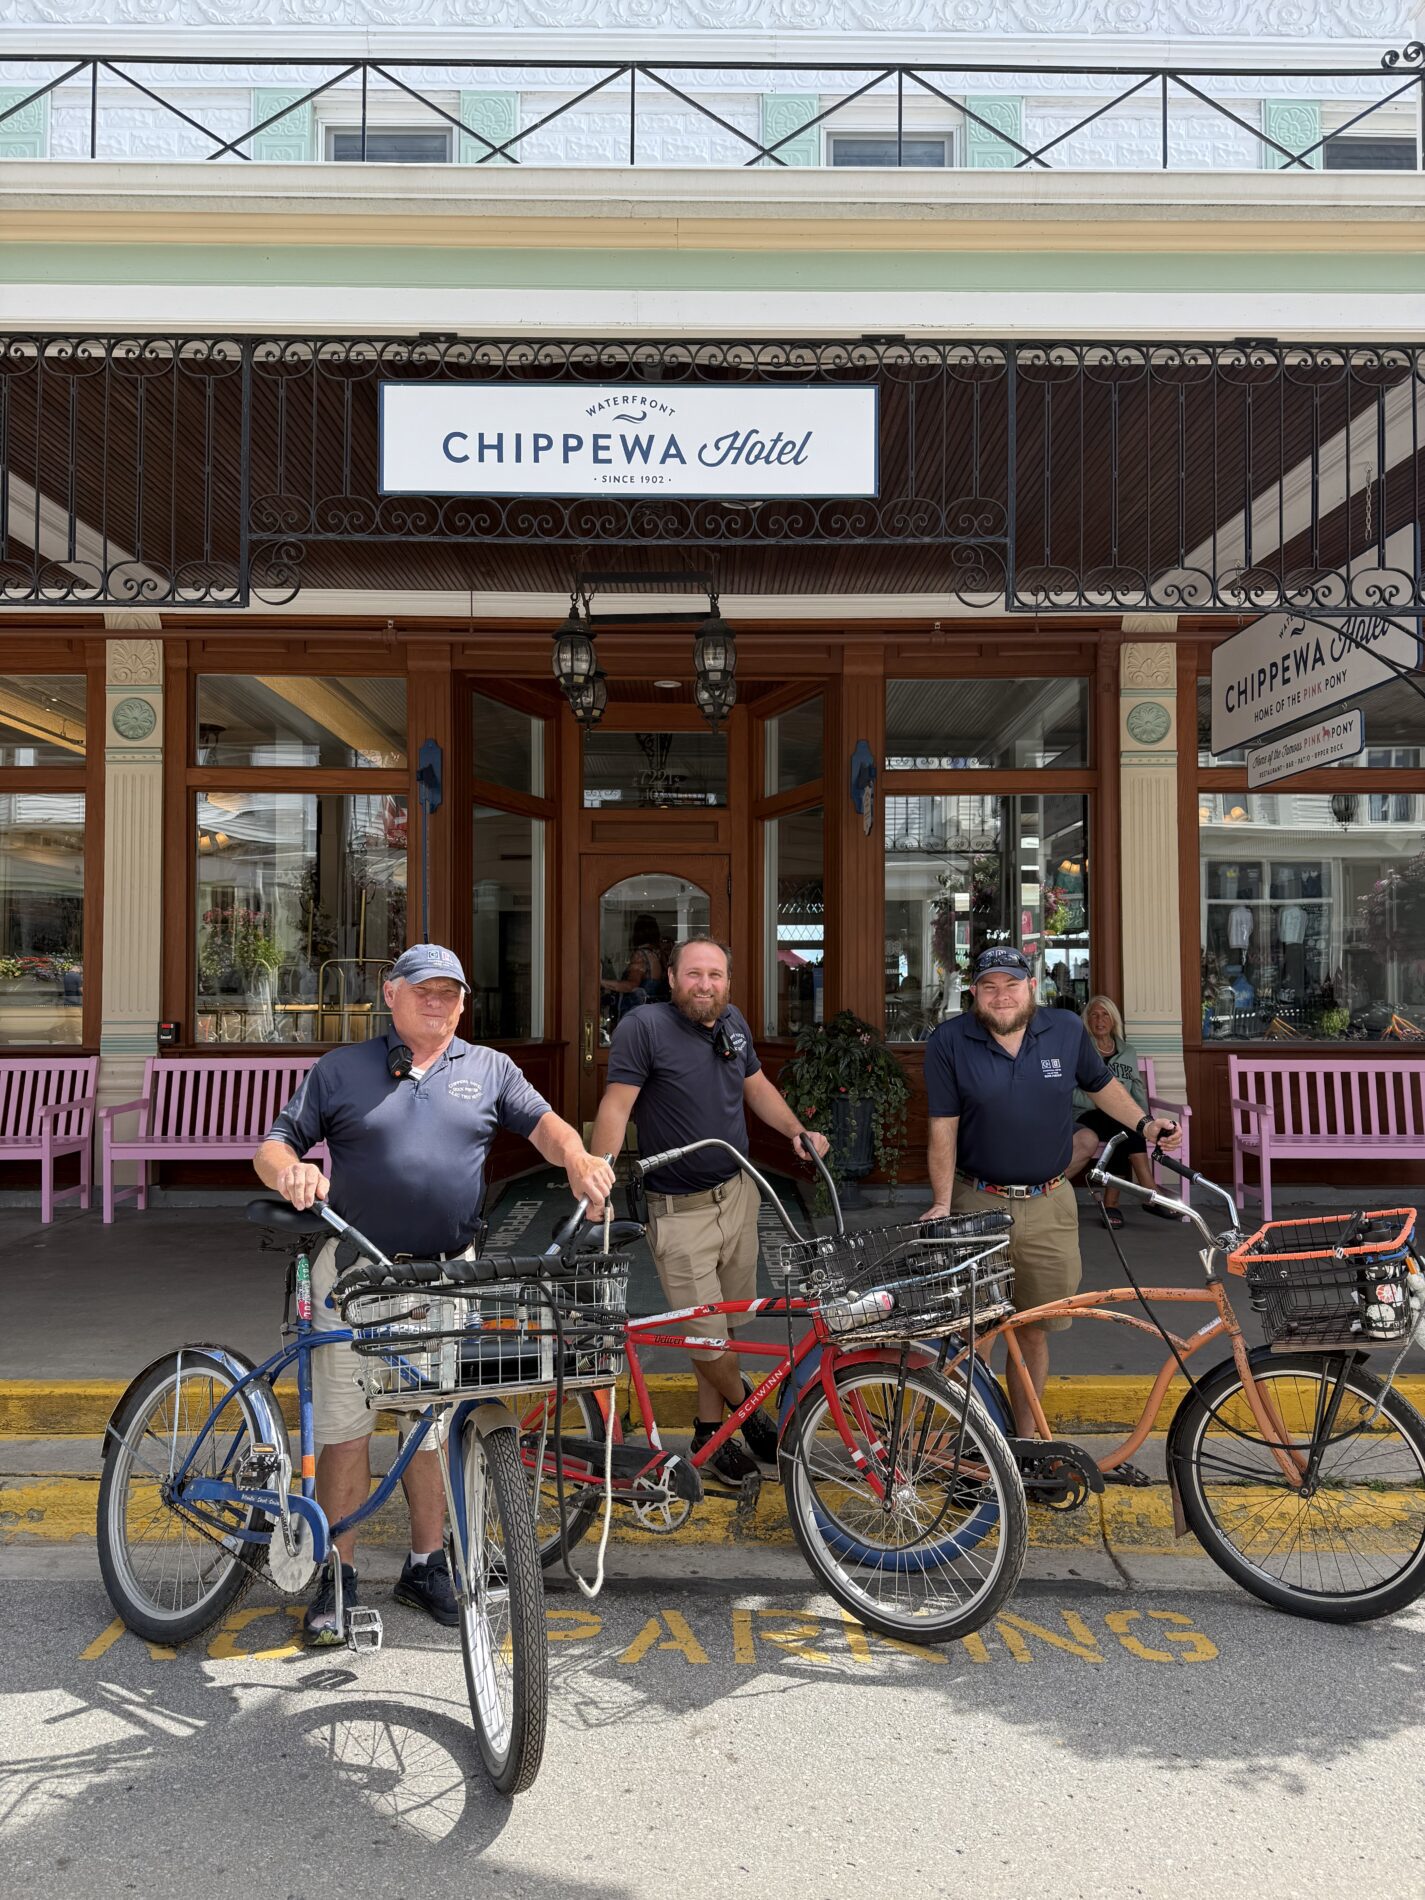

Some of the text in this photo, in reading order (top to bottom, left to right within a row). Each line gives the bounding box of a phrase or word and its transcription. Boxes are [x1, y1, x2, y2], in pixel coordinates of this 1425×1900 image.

[585, 395, 676, 418] WATERFRONT
[442, 428, 813, 468] CHIPPEWA Hotel
[601, 475, 665, 484] SINCE 1902
[1225, 637, 1326, 713] CHIPPEWA
[1254, 669, 1348, 723] HOME OF THE PINK PONY
[1303, 736, 1321, 748] PINK
[1331, 720, 1354, 738] PONY
[485, 1200, 544, 1247] CHIPPEWA
[737, 1368, 784, 1419] SCHWINN
